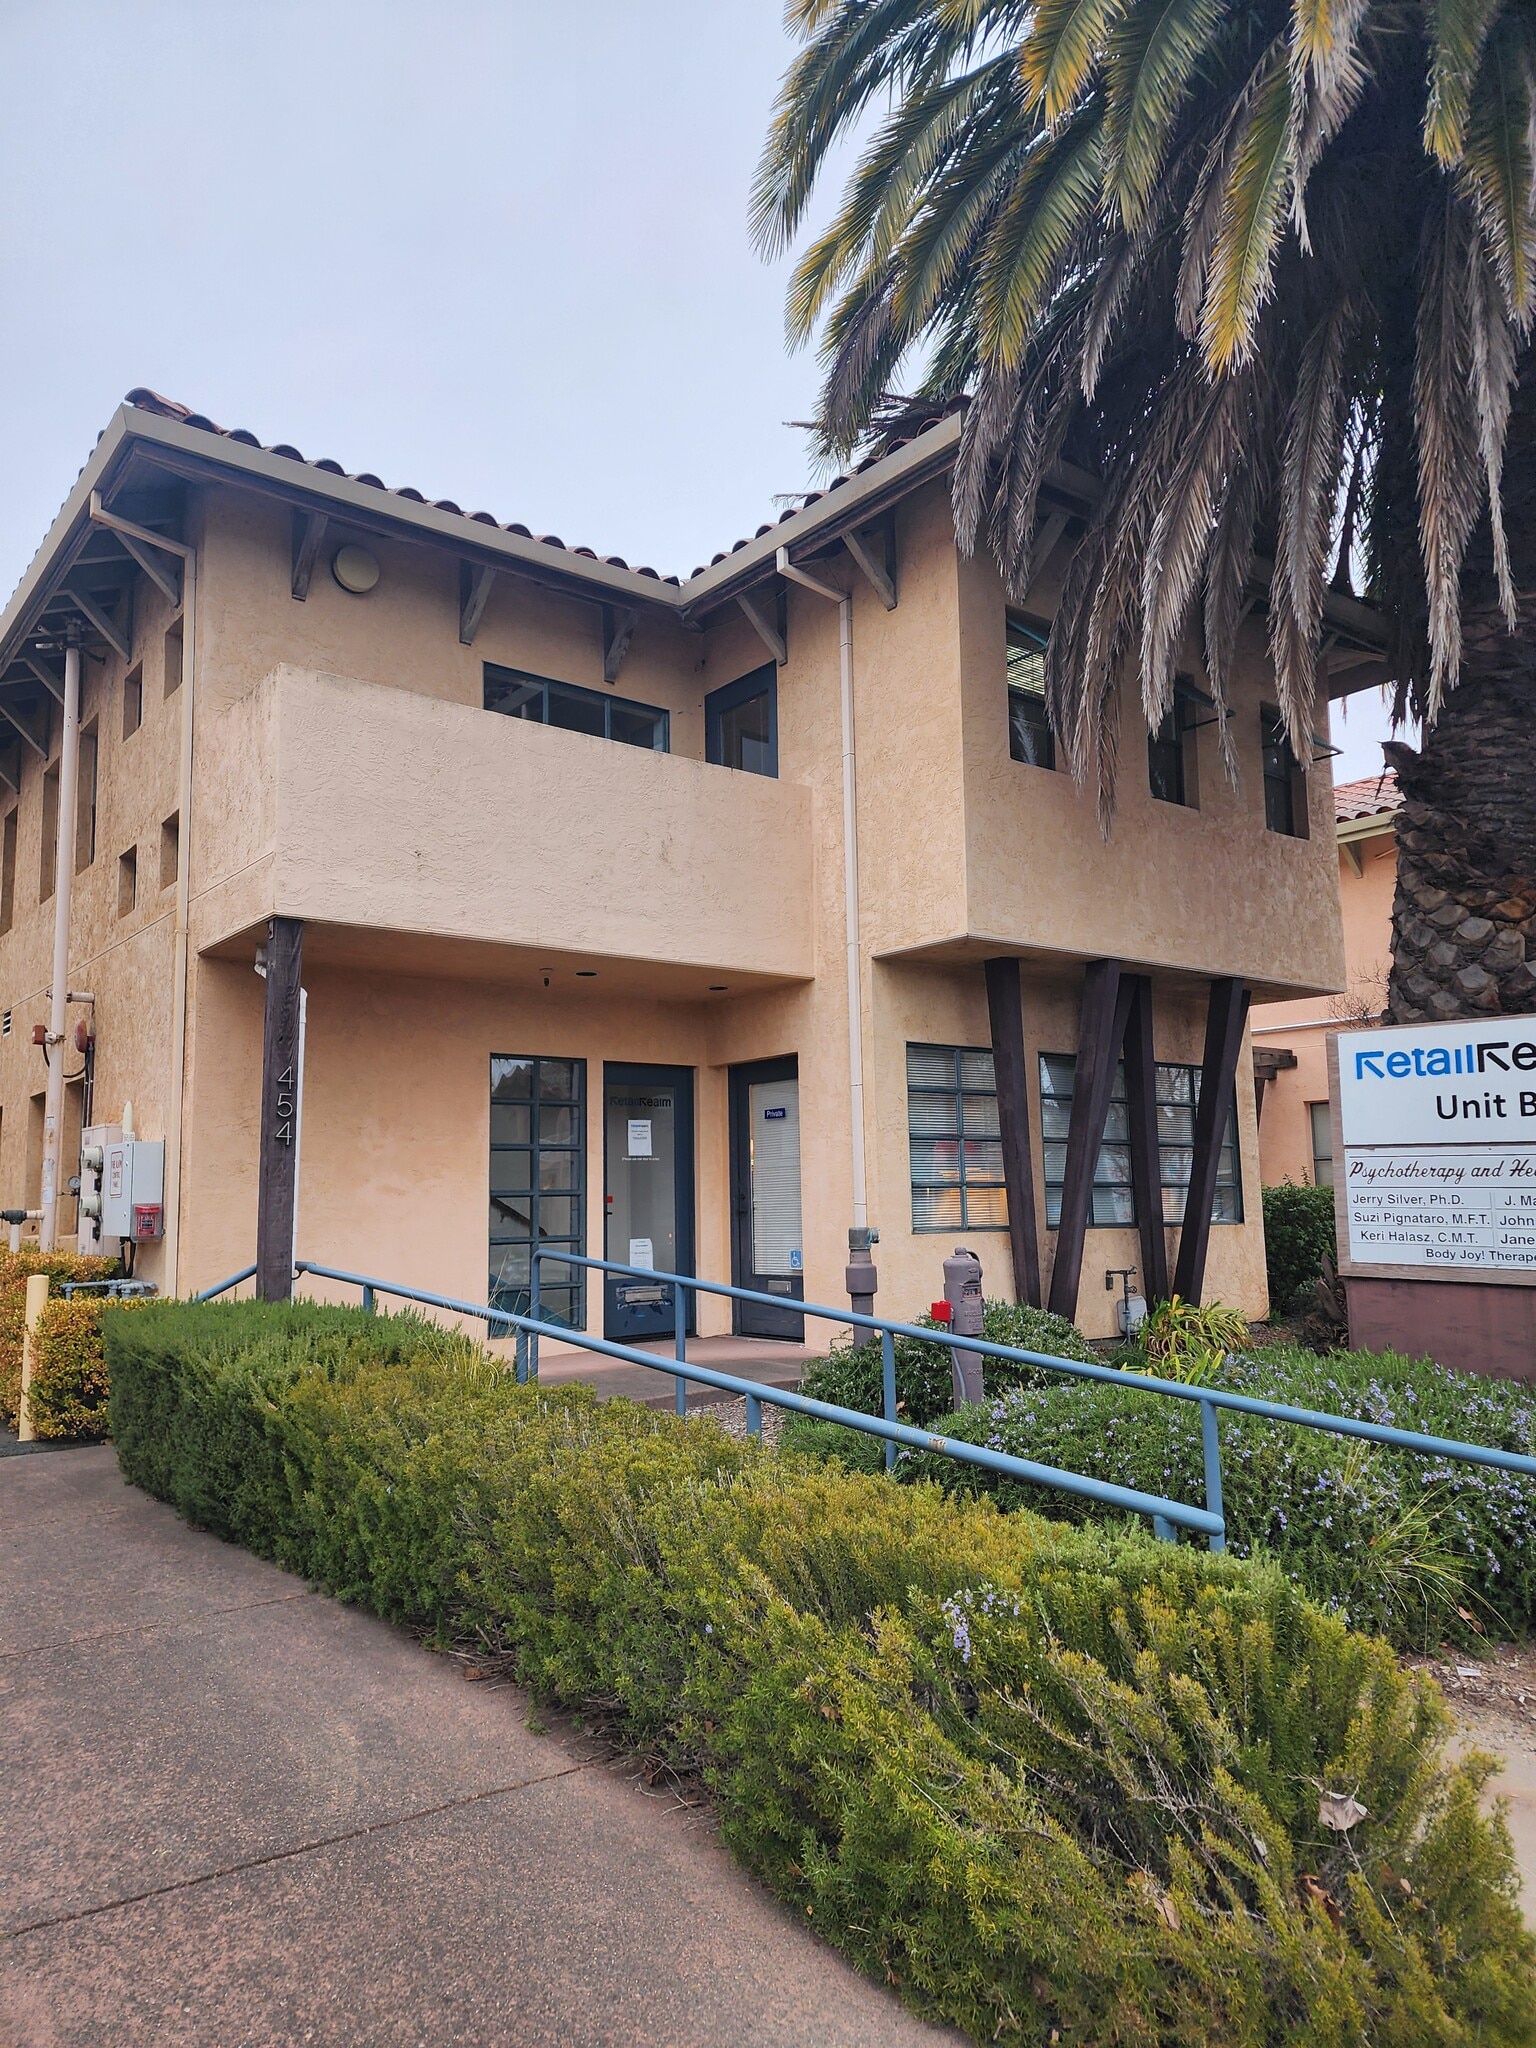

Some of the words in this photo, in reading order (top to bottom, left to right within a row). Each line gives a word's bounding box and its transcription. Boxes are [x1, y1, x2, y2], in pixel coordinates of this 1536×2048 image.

[1436, 1092, 1507, 1119] Unit
[1519, 1091, 1536, 1117] B
[1349, 1160, 1467, 1184] Psychotherapy
[1471, 1160, 1504, 1177] and
[1508, 1158, 1536, 1178] He
[1352, 1193, 1383, 1207] Jerry
[1387, 1194, 1426, 1206] Silver,
[1429, 1194, 1464, 1205] Ph.D.
[1504, 1195, 1516, 1206] J.
[1353, 1211, 1380, 1223] Suzi
[1383, 1212, 1449, 1226] Pignataro,
[1451, 1213, 1490, 1225] M.F.T.
[1499, 1215, 1535, 1226] John
[1360, 1230, 1385, 1241] Keri
[1388, 1231, 1434, 1243] Halasz,
[1437, 1231, 1478, 1244] C.M.T.
[1500, 1233, 1536, 1245] Jane
[1425, 1248, 1457, 1261] Body
[1459, 1249, 1485, 1262] Joy!
[1488, 1250, 1536, 1264] Therap
